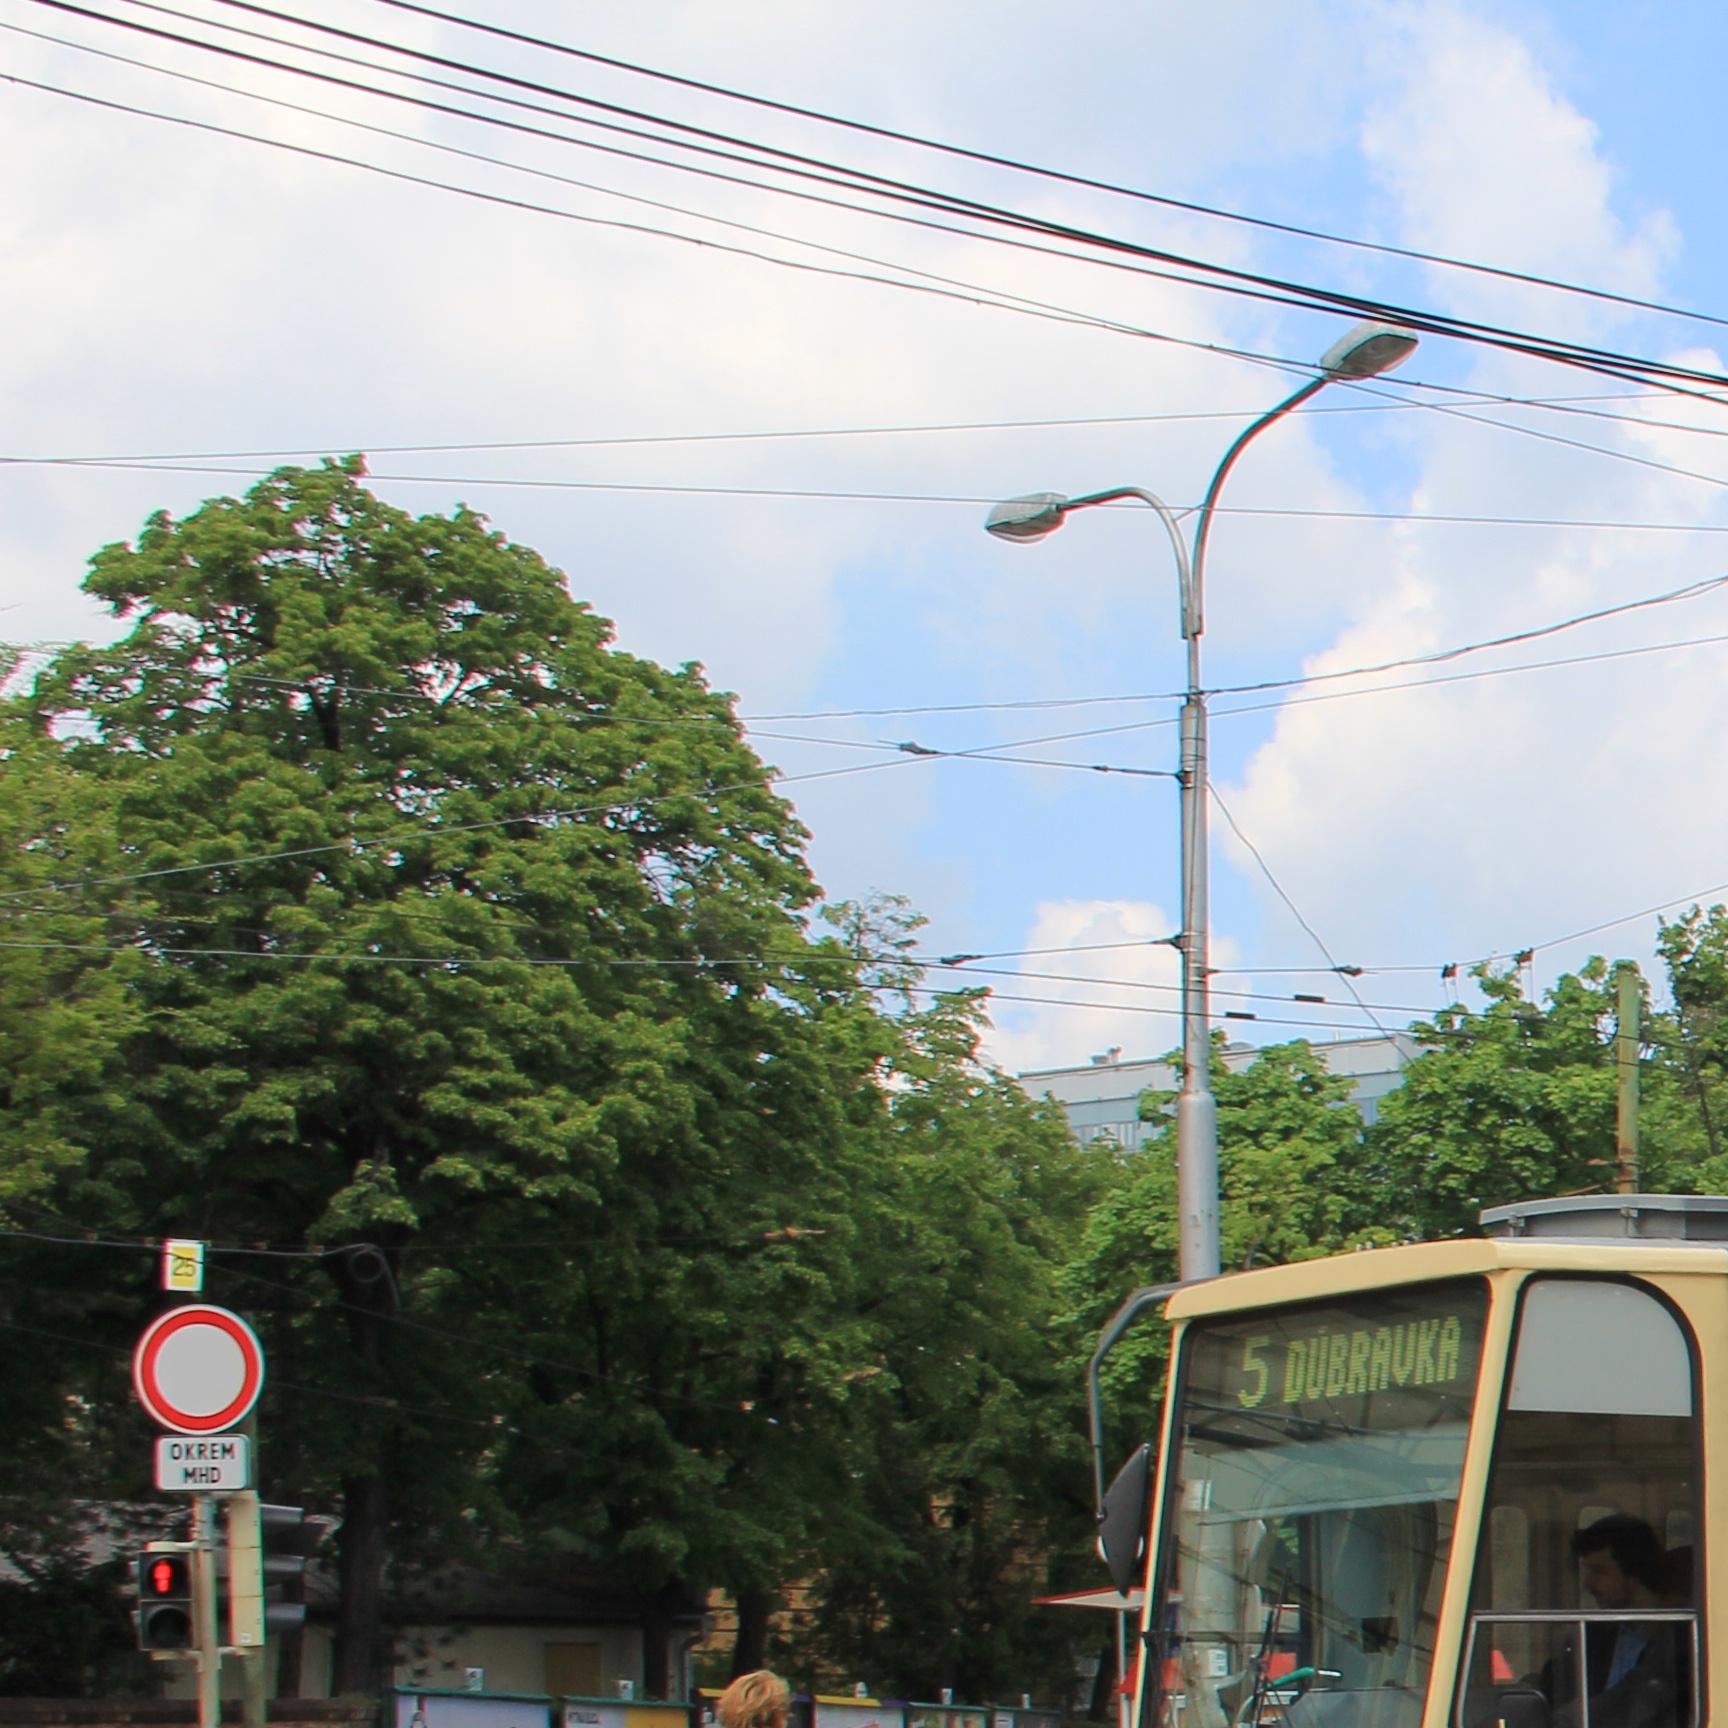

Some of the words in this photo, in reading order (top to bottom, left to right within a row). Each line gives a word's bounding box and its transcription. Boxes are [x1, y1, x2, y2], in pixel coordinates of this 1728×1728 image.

[172, 1254, 196, 1277] 25
[1238, 1335, 1270, 1408] 5
[1283, 1316, 1461, 1404] DÚBRAVKA
[170, 1443, 235, 1460] OKREM
[184, 1467, 221, 1483] MHD
